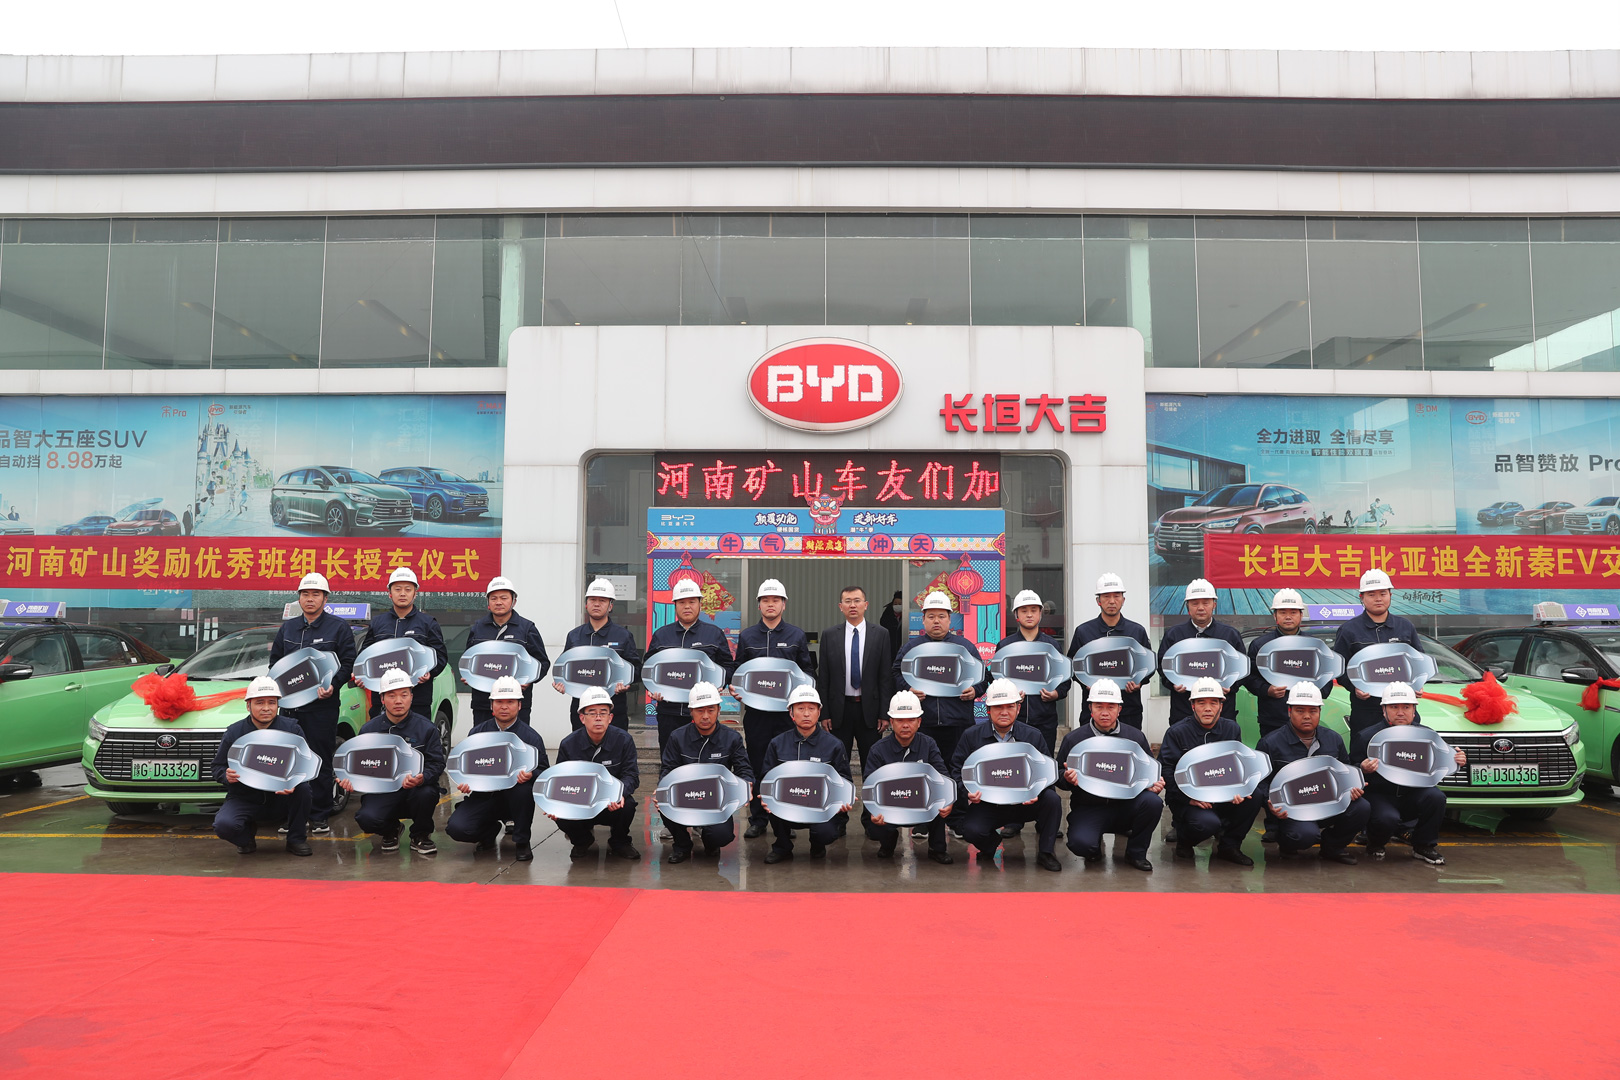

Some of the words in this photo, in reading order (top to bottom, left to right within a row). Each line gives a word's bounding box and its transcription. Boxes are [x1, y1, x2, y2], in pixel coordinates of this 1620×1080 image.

[767, 364, 883, 403] BYD
[940, 393, 1108, 433] 长垣大吉
[1256, 428, 1321, 445] 全力进取
[1330, 429, 1394, 445] 全情尽享
[1494, 453, 1579, 473] 品智赞放
[657, 459, 999, 502] 河南矿山车友们加
[723, 537, 738, 551] 牛
[764, 537, 780, 551] 气
[873, 537, 888, 551] 冲
[913, 538, 929, 551] 天
[6, 546, 480, 580] 河南矿山奖励优秀班组长授车仪式
[154, 763, 198, 777] D33329
[1493, 767, 1538, 782] D30336
